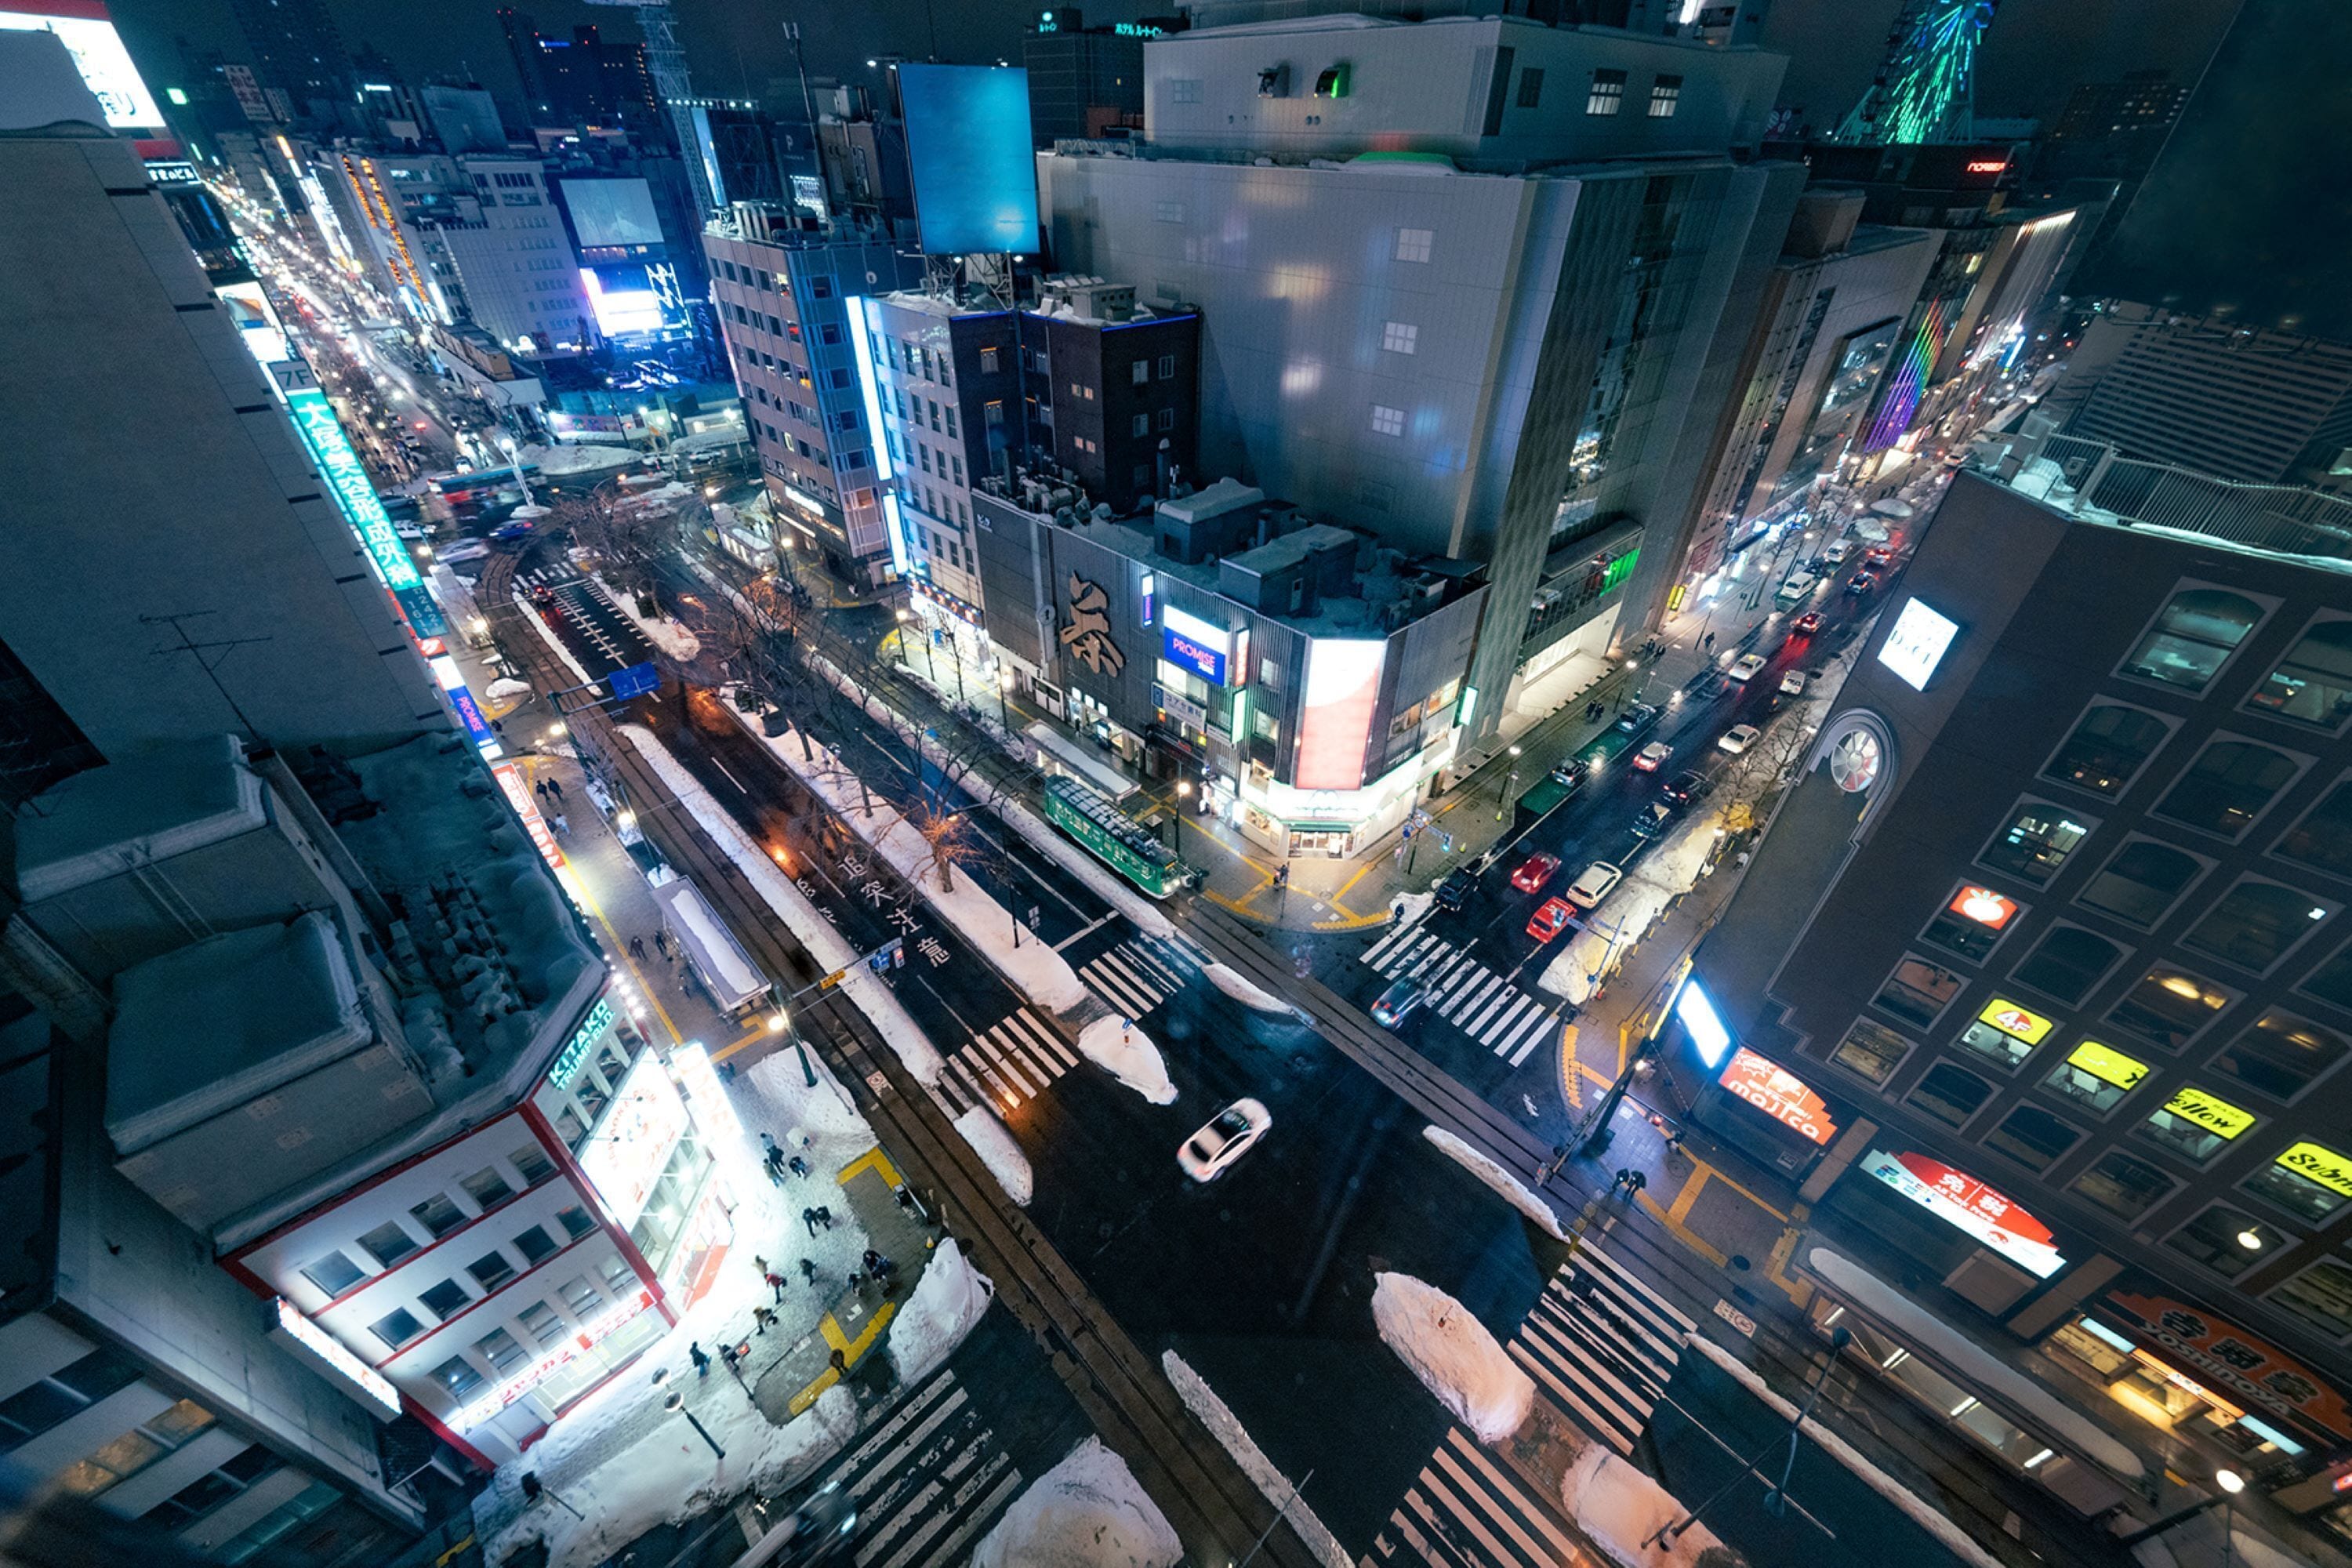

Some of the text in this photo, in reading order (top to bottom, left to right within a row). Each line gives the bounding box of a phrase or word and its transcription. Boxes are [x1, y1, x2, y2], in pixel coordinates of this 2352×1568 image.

[278, 368, 310, 387] 7F
[296, 401, 419, 586] 大塚美容形成外科
[1172, 637, 1215, 668] PROMISE
[456, 695, 485, 733] PROMISE
[549, 998, 608, 1084] KITAKO
[1994, 1011, 2031, 1032] 4F
[557, 1040, 592, 1091] TRUMP
[1728, 1080, 1820, 1139] majica
